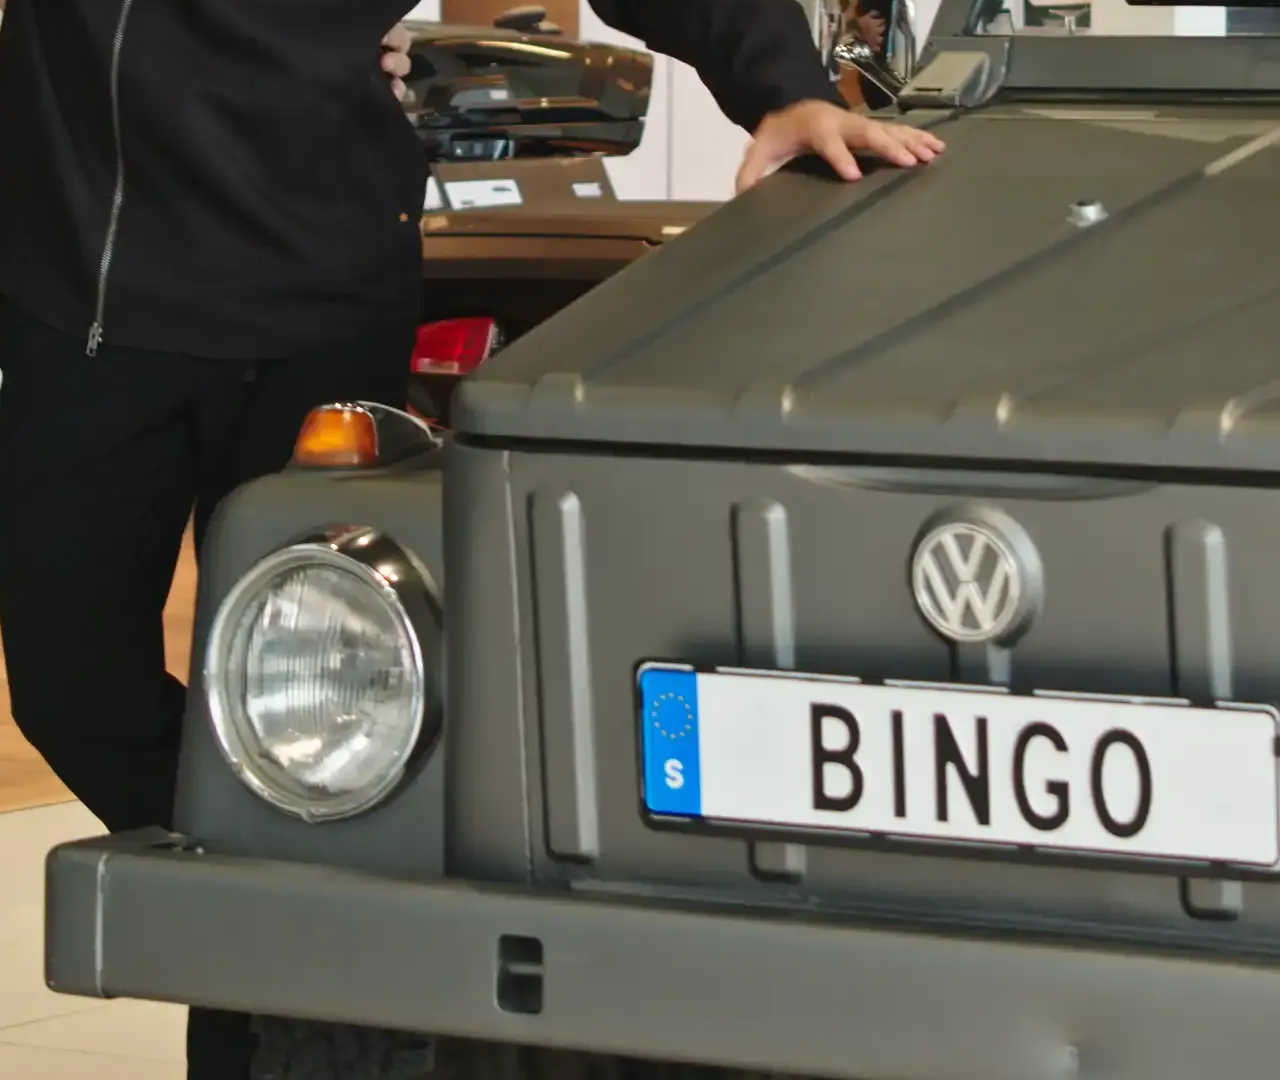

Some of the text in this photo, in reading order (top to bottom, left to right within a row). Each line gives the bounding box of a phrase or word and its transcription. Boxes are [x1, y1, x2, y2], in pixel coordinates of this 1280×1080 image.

[916, 528, 1017, 636] VW
[661, 757, 687, 791] S
[808, 700, 1153, 838] BINGO
